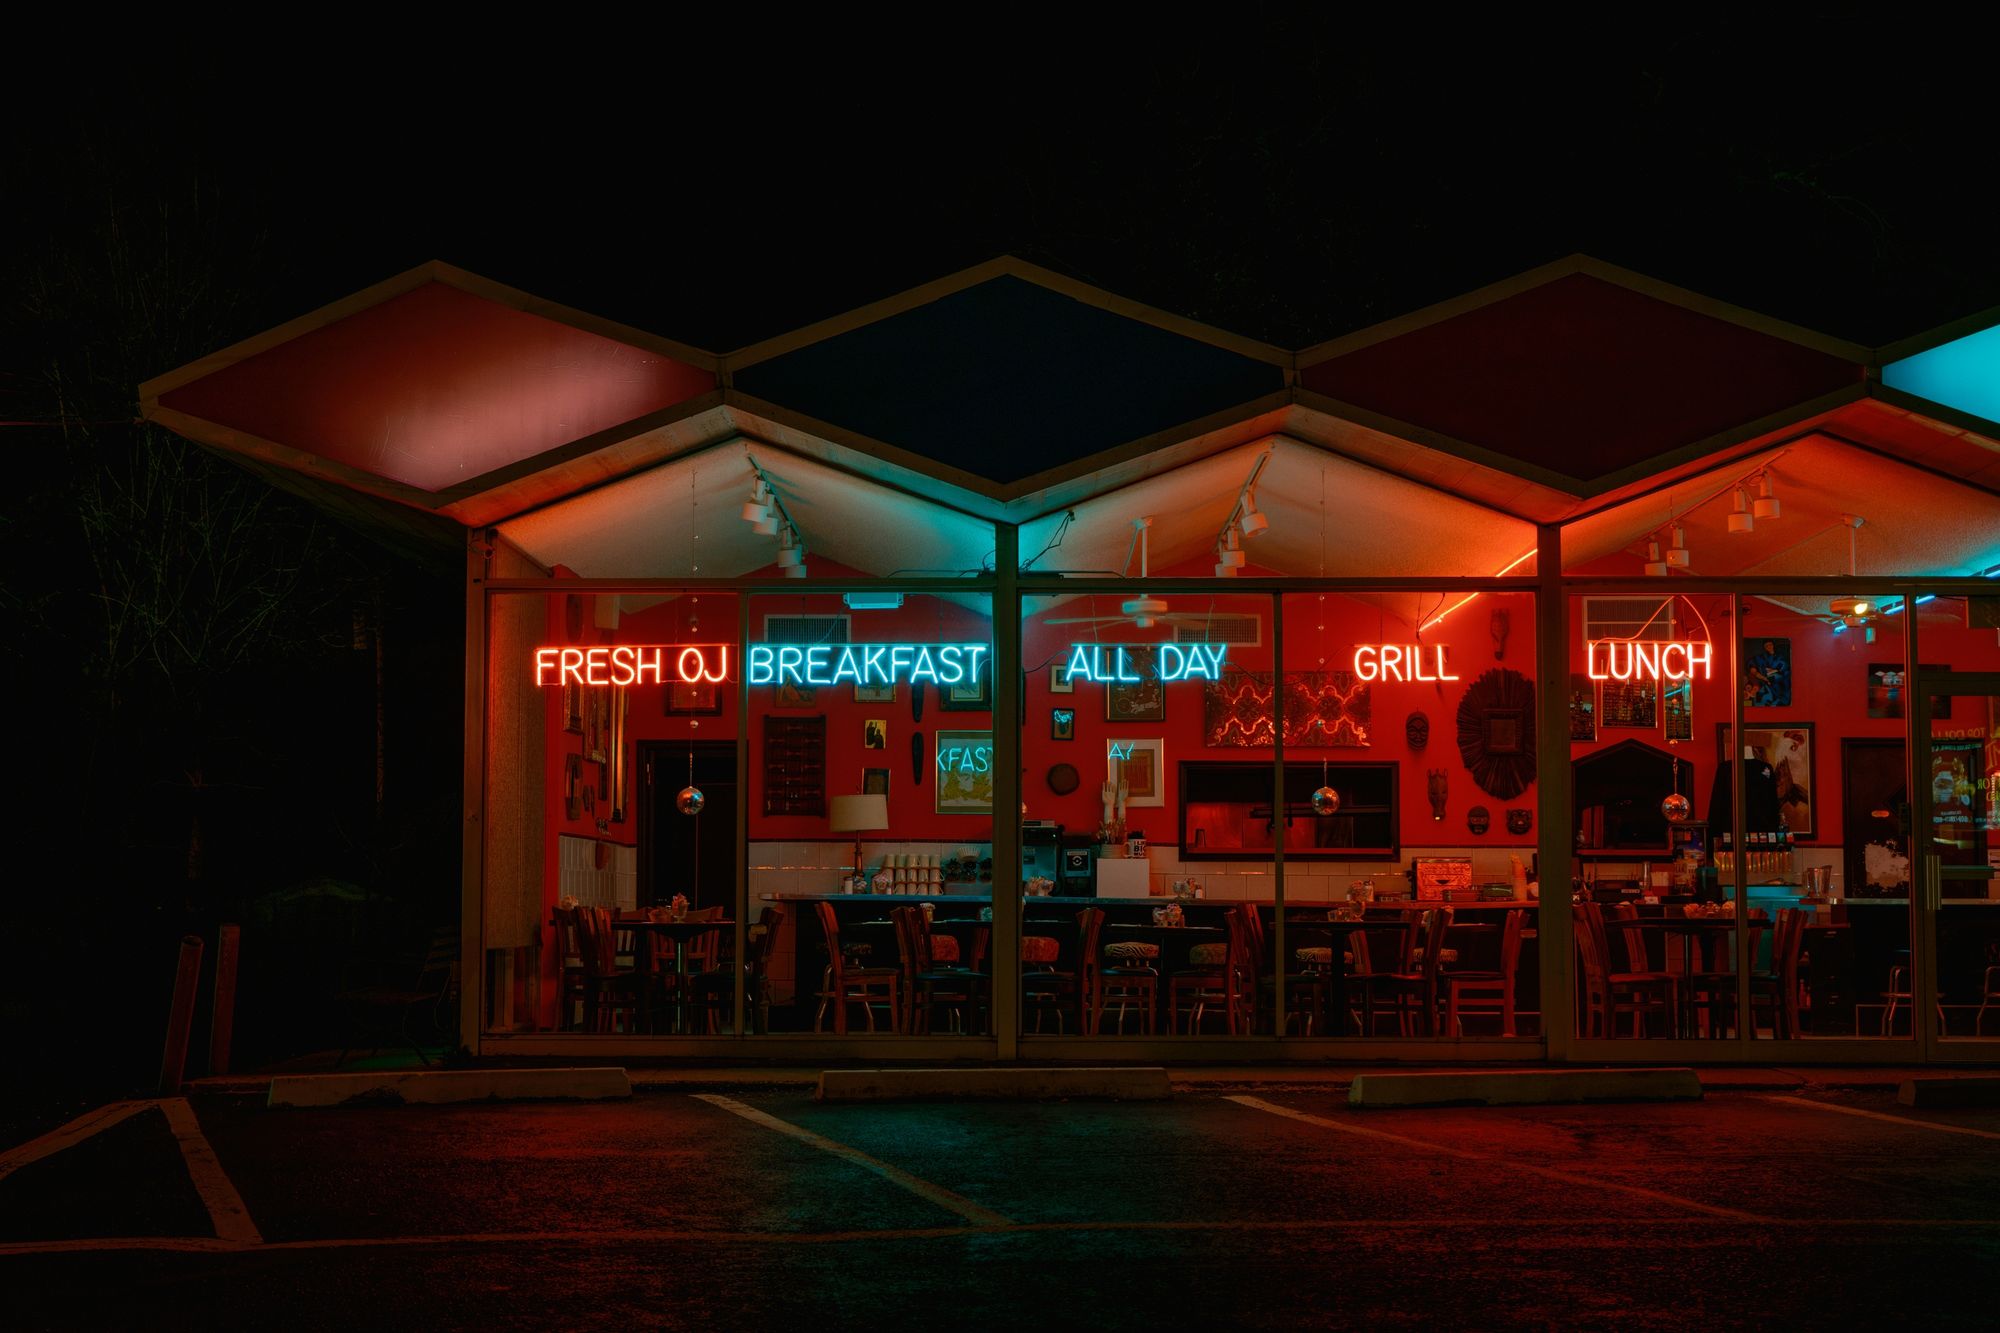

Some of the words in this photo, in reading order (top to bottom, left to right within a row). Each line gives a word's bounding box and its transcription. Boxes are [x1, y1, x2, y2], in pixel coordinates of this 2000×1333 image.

[535, 646, 661, 686] FRESH
[678, 645, 727, 683] OJ
[749, 645, 987, 685] BREAKFAST
[1065, 645, 1141, 682] ALL
[1160, 643, 1227, 681] DAY
[1353, 644, 1460, 682] GRILL
[1587, 641, 1711, 680] LUNCH
